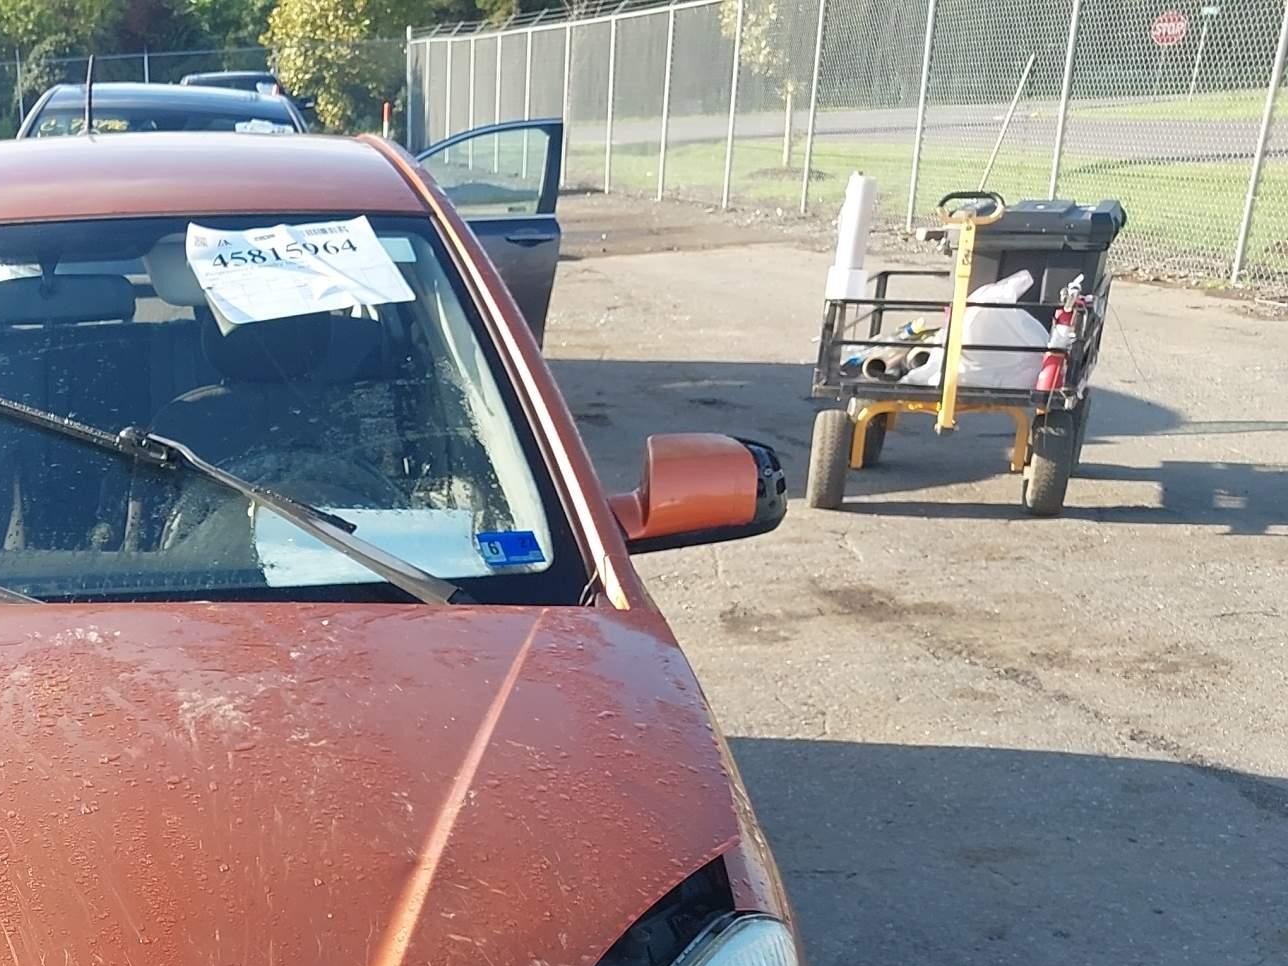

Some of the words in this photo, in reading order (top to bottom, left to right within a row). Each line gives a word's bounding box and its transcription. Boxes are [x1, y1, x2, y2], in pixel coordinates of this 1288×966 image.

[1154, 22, 1185, 36] STOP
[212, 238, 359, 269] 45815964
[487, 540, 500, 555] 6
